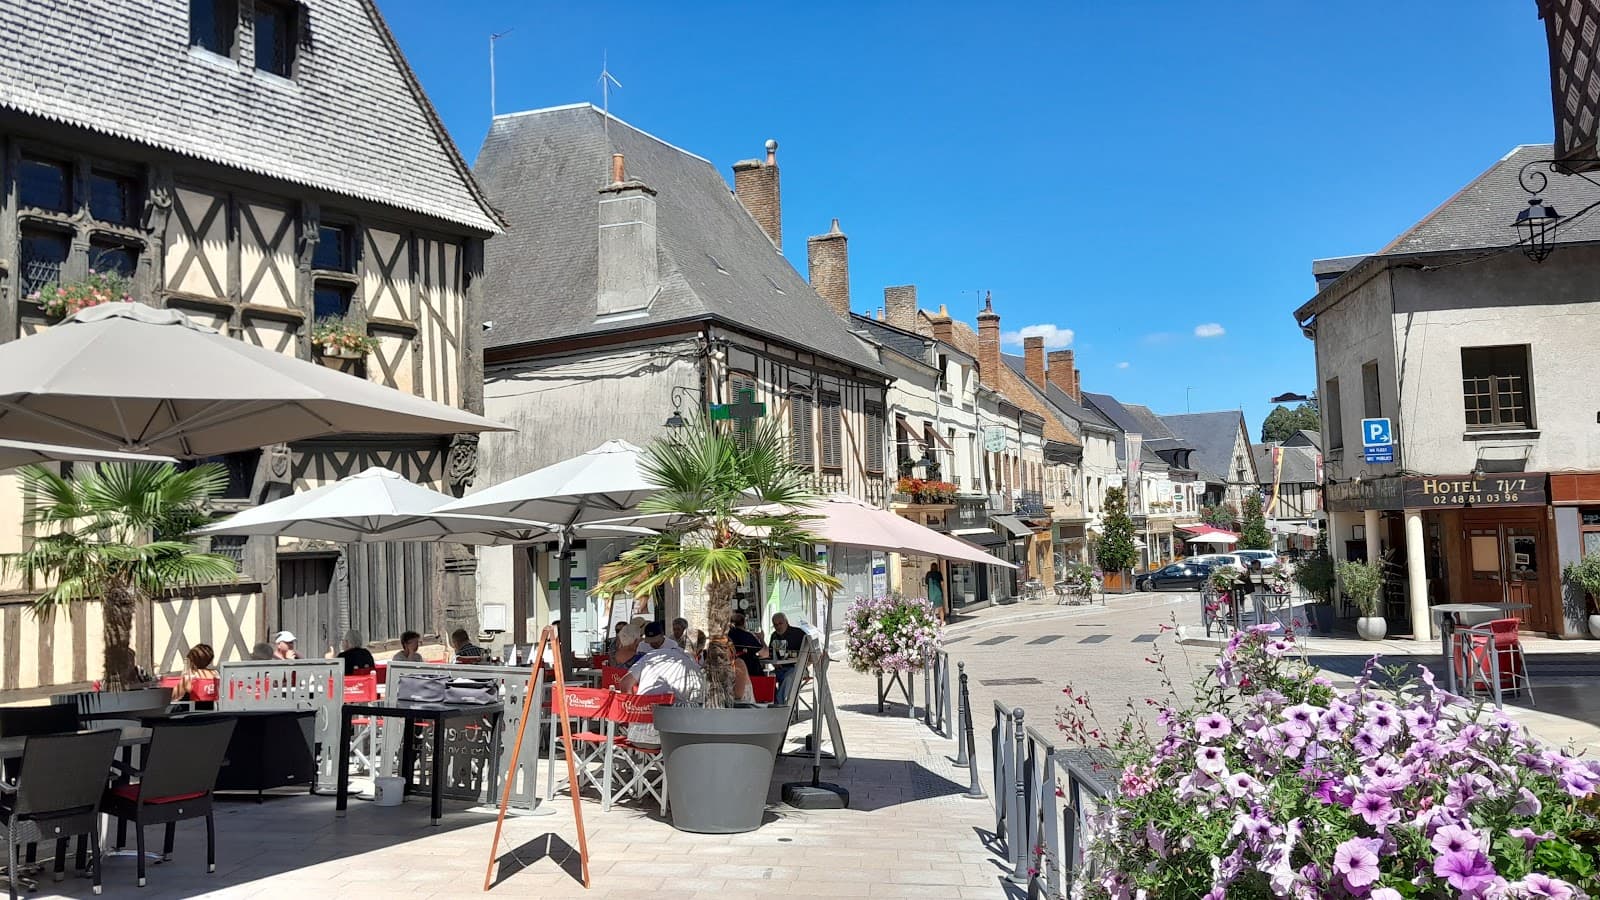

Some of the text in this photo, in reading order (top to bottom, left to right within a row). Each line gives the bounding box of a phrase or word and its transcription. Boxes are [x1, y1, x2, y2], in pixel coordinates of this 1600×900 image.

[1370, 423, 1383, 441] P
[1423, 480, 1481, 494] HOTEL
[1433, 492, 1519, 505] 02 48 81 03 96
